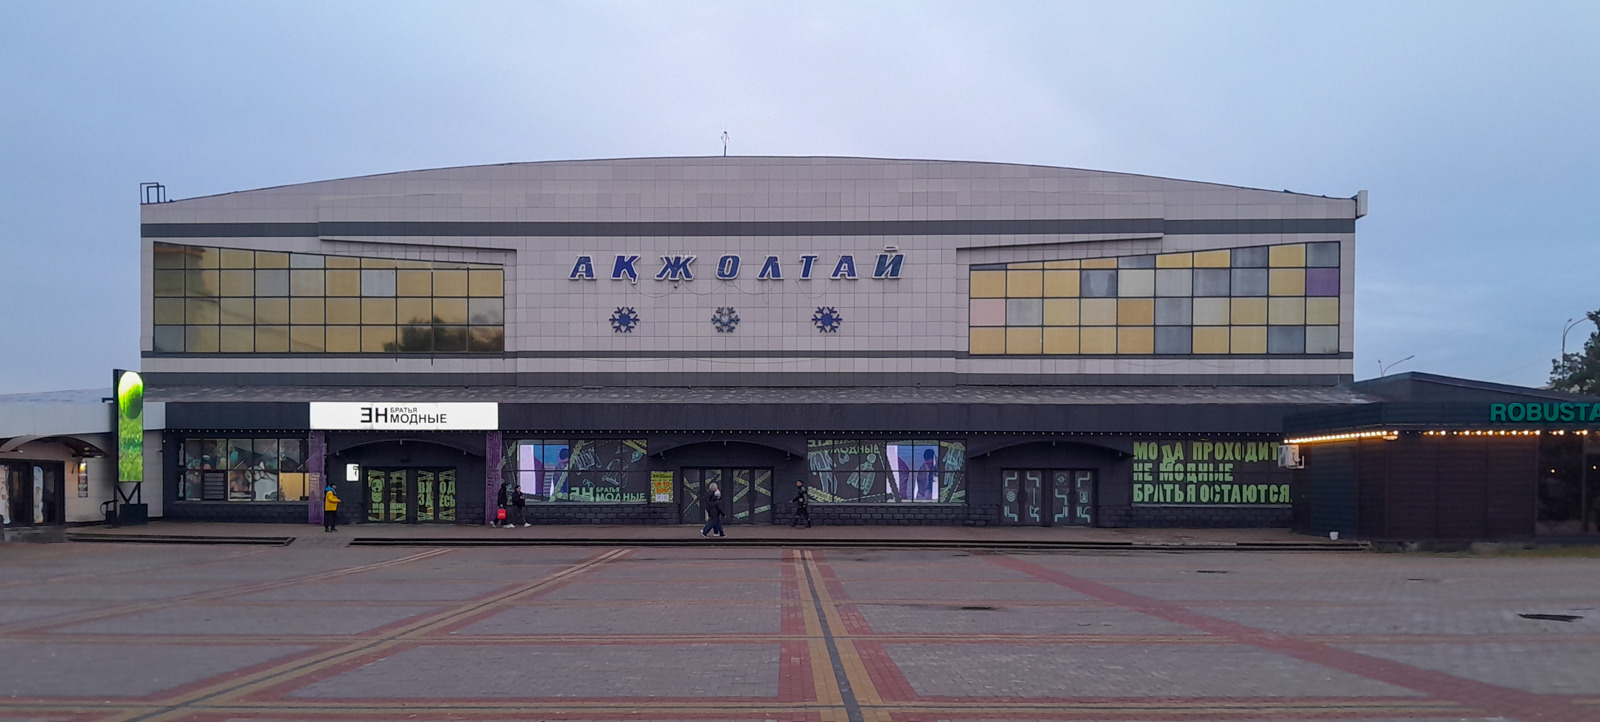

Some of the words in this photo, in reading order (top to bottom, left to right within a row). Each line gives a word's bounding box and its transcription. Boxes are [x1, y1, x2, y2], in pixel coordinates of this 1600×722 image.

[390, 414, 447, 425] МОДНЫЕ
[1133, 442, 1184, 463] МОДА
[1193, 442, 1280, 463] ПРОХОДИТ
[1133, 463, 1153, 481] НЕ
[1159, 463, 1234, 484] МОДНЫЕ
[418, 481, 456, 494] ВХОД
[1133, 484, 1196, 503] БРАТЬЯ
[596, 493, 646, 502] МОДНЫЕ
